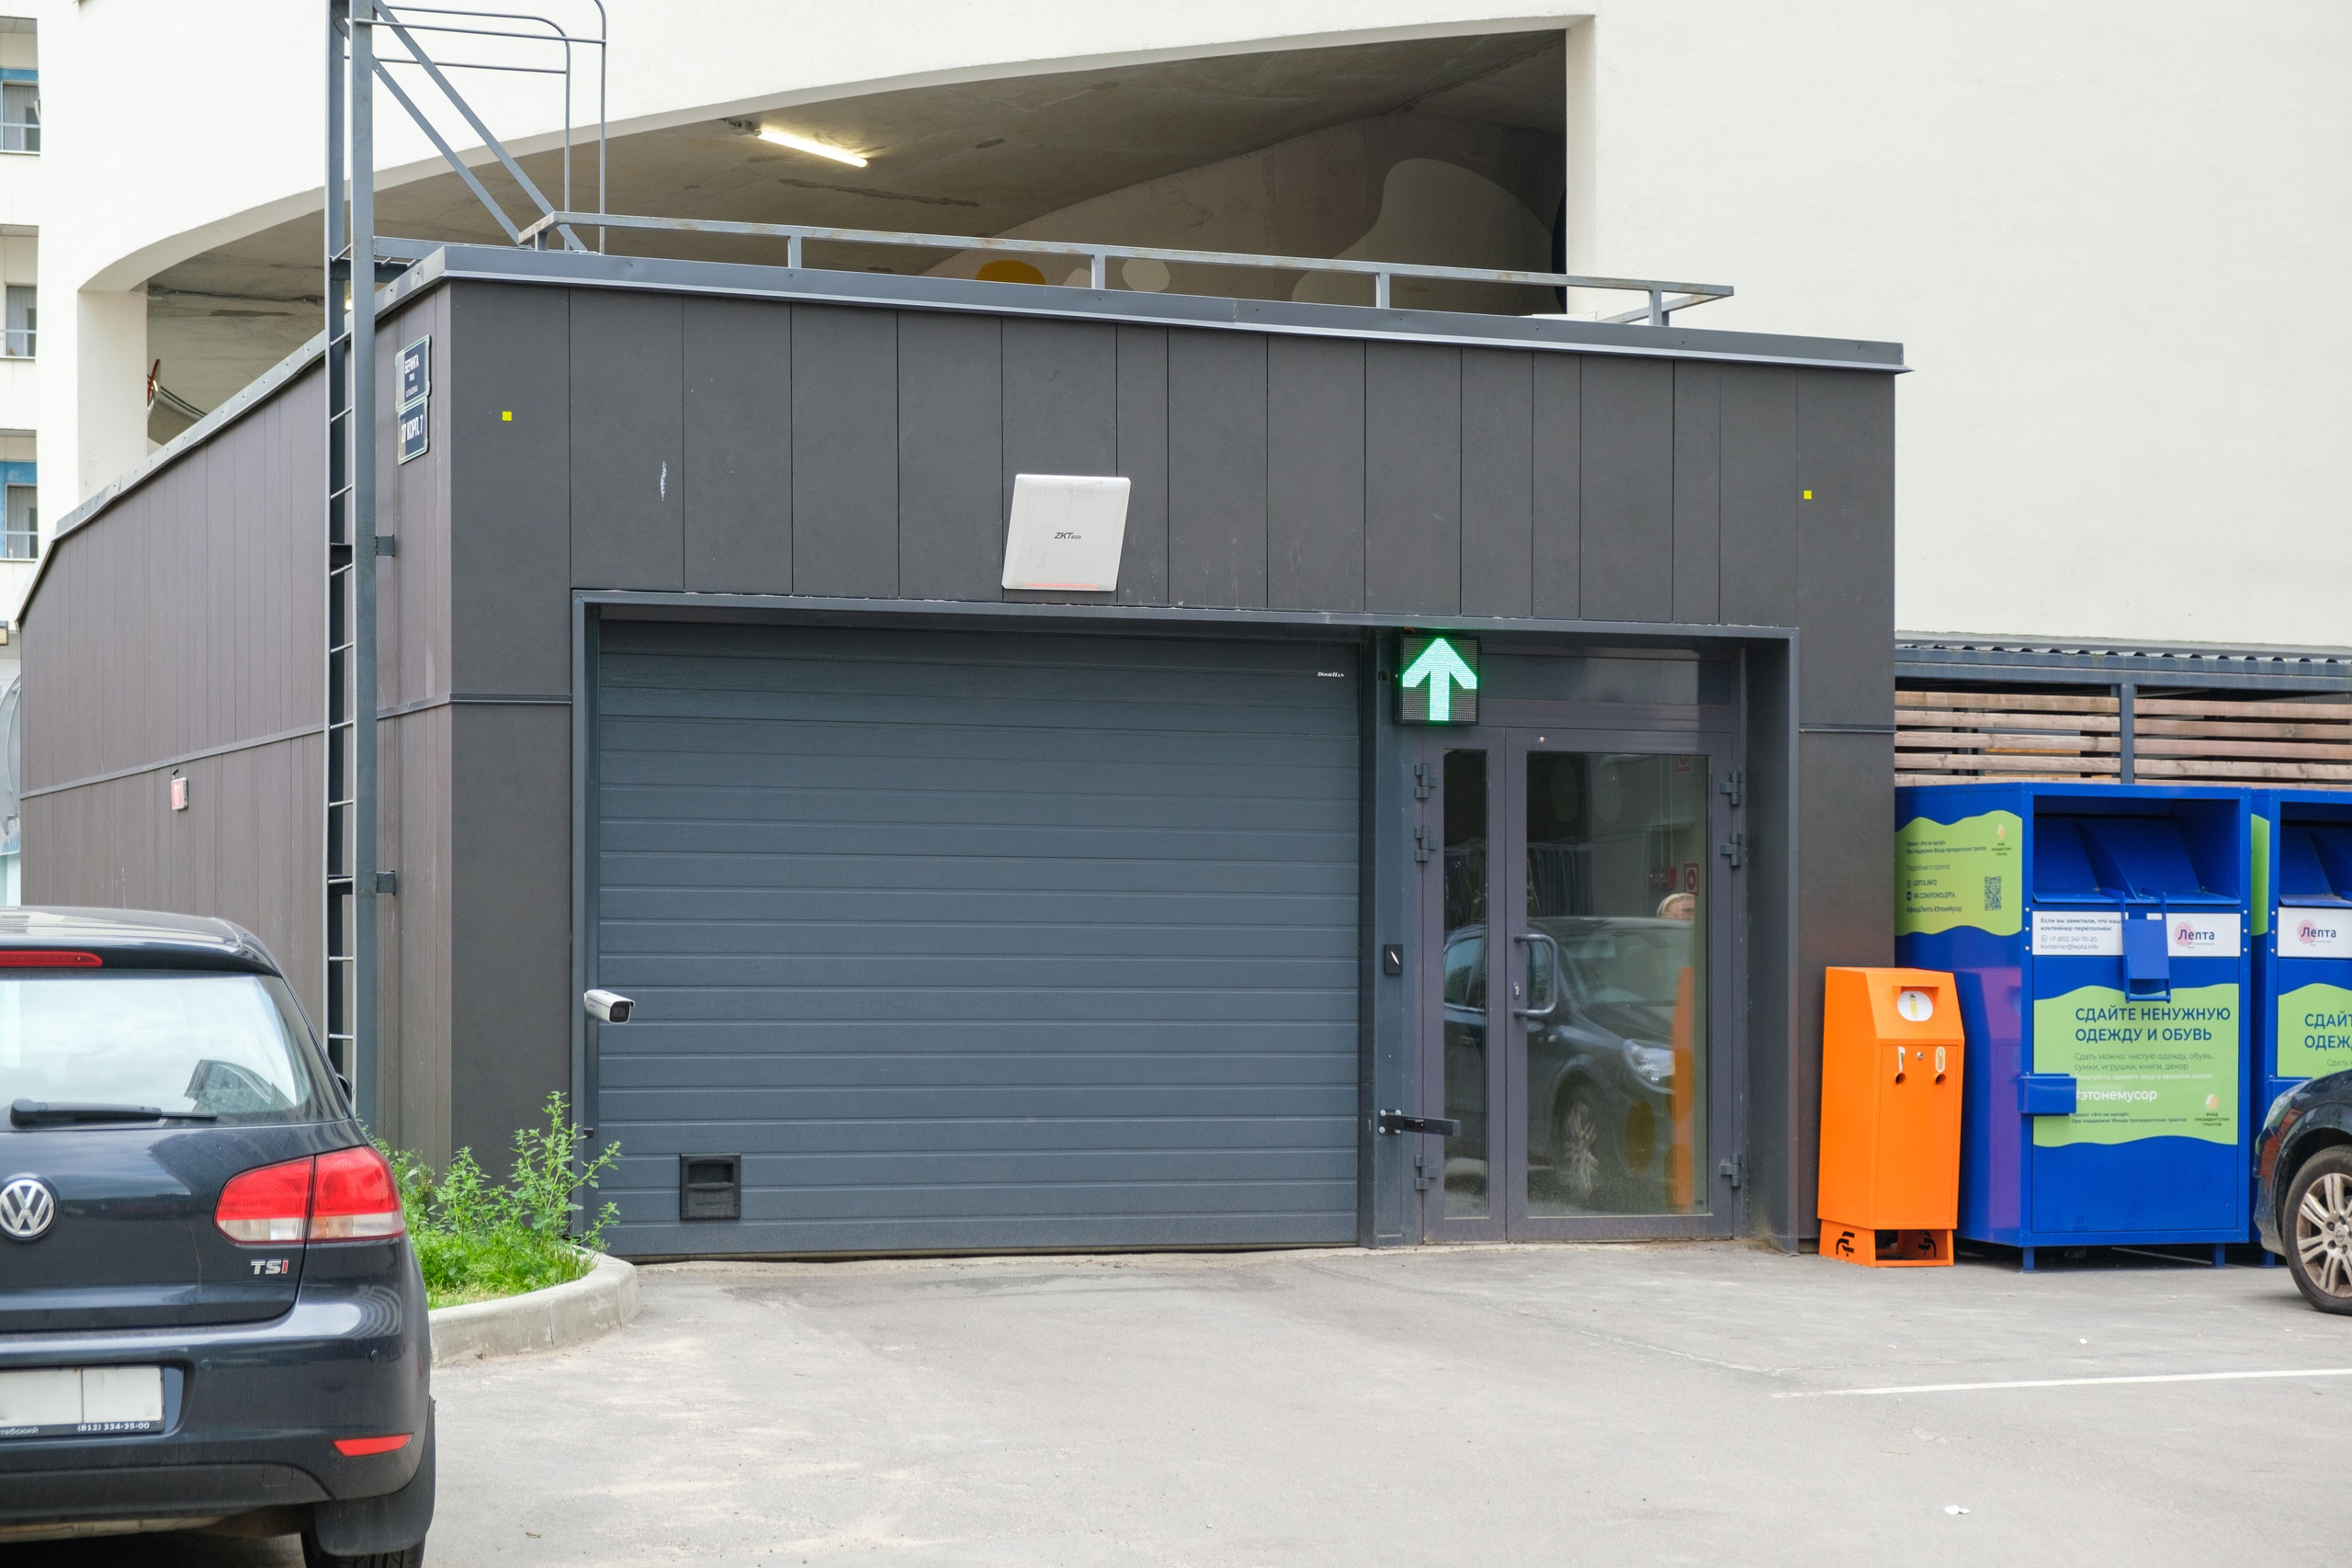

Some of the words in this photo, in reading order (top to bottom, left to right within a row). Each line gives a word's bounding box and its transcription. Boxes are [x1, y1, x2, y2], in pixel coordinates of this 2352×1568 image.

[2177, 929, 2215, 941] Лепта
[2301, 927, 2336, 938] Лепта
[2075, 1005, 2136, 1022] СДАЙТЕ
[2142, 1008, 2231, 1021] НЕНУЖНУЮ
[2075, 1029, 2143, 1043] ОДЕЖДУ
[2147, 1029, 2157, 1041] И
[2162, 1029, 2212, 1041] ОБУВЬ
[2304, 1035, 2352, 1051] ОДЕЖ
[2189, 1052, 2213, 1061] обувь,
[77, 1424, 101, 1432] (812)
[104, 1422, 150, 1431] 334-35-00
